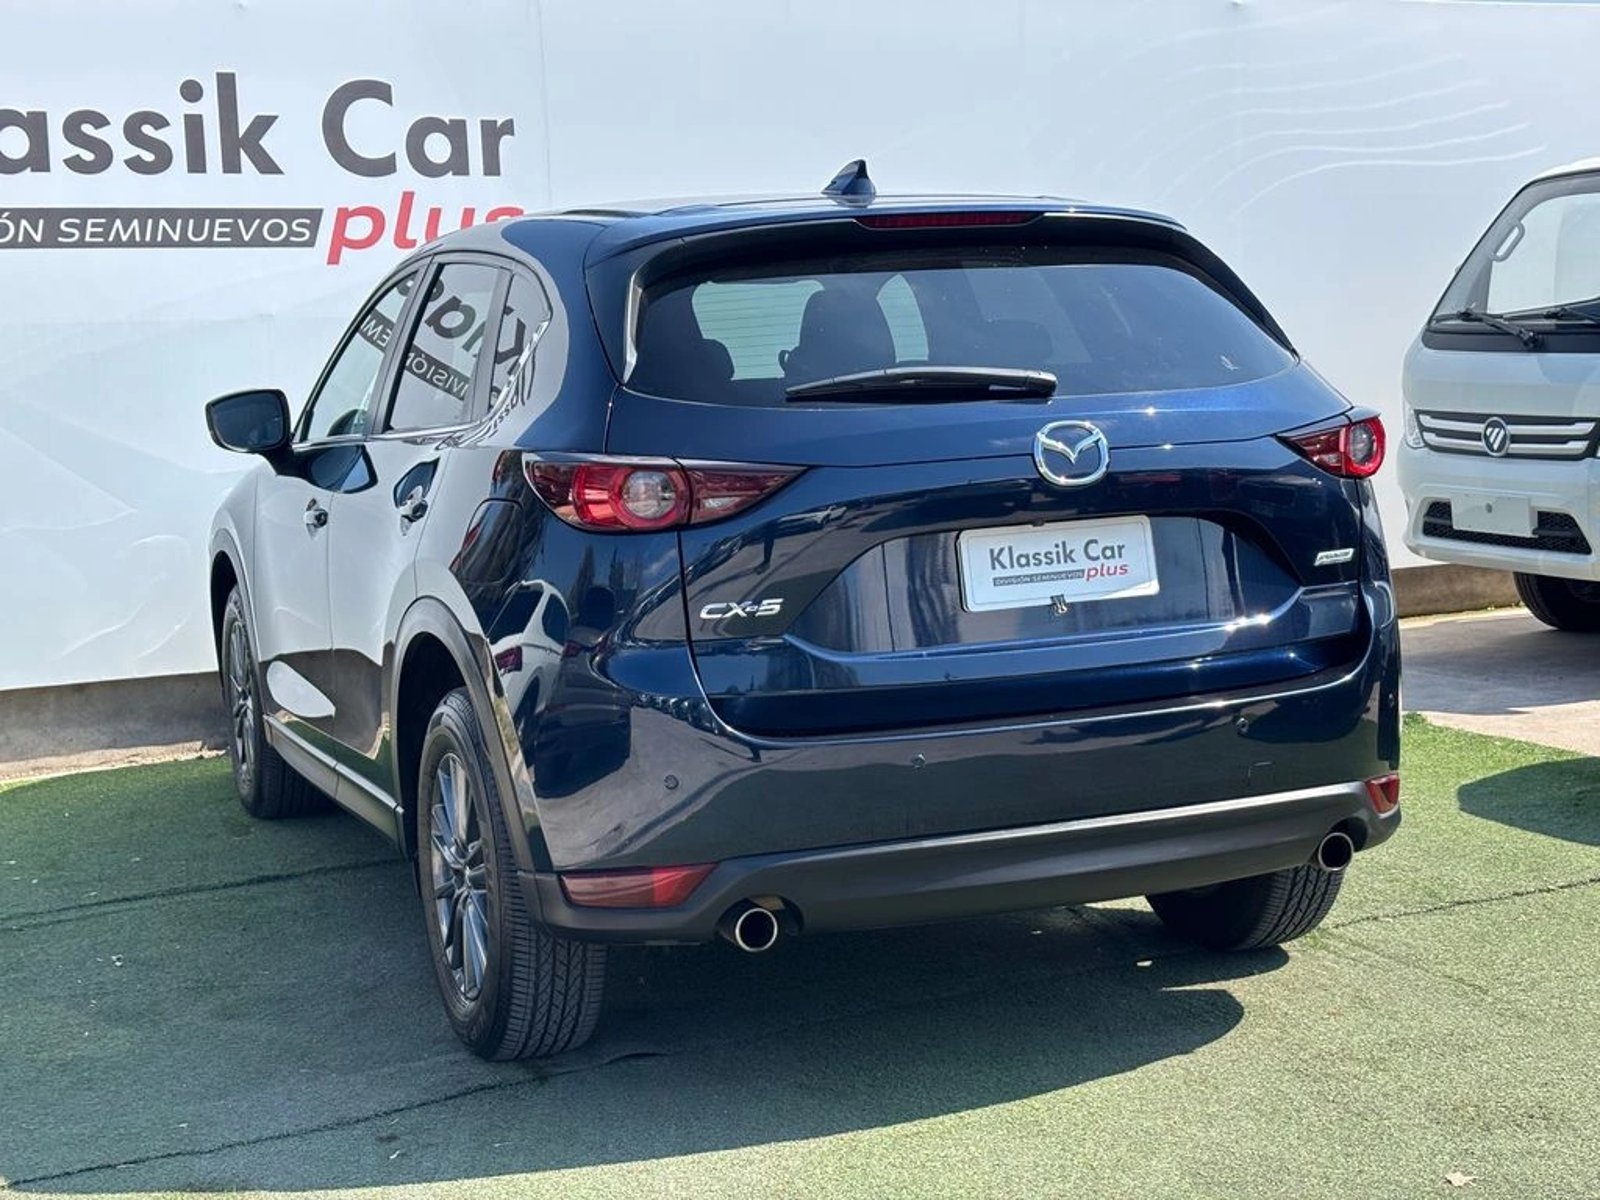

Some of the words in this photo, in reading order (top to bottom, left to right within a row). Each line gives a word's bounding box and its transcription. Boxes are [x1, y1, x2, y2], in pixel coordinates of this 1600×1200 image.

[321, 79, 515, 178] Car
[57, 217, 312, 244] SEMINUEVOS
[989, 540, 1077, 571] Klassik
[1083, 538, 1126, 561] Car
[1086, 563, 1129, 582] plus
[700, 598, 785, 620] CX-5
